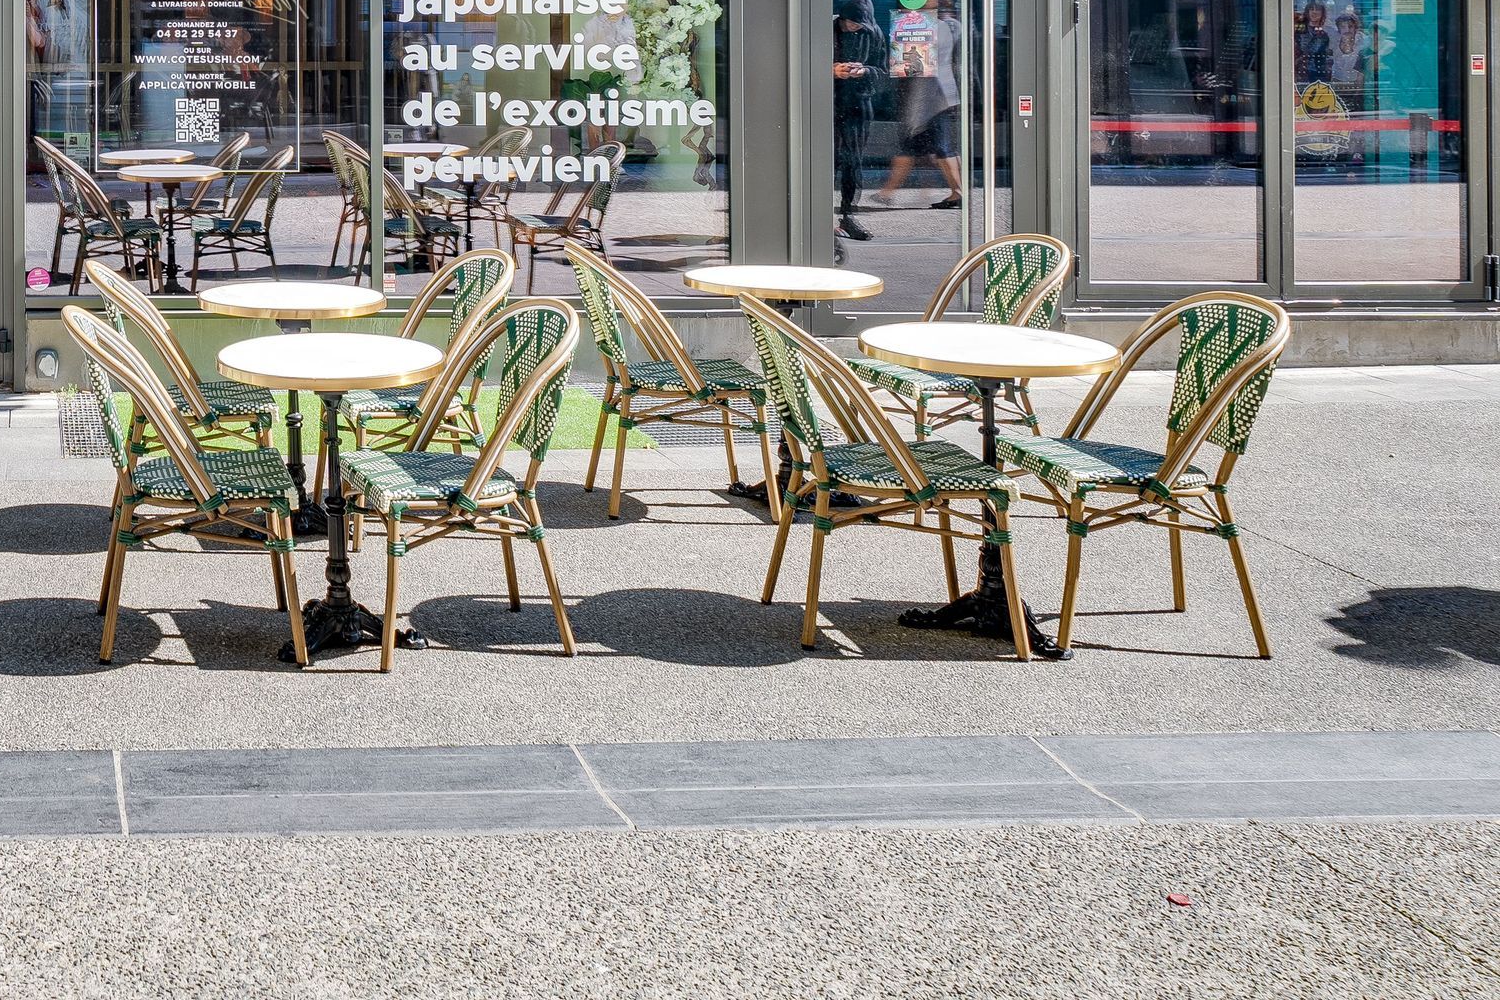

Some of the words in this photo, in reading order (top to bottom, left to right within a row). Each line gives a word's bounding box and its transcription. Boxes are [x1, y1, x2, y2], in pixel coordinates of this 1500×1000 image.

[157, 30, 171, 38] 04
[174, 30, 188, 38] 82
[191, 30, 204, 38] 29
[207, 30, 221, 38] 54
[225, 30, 238, 38] 37
[402, 43, 457, 70] au
[471, 34, 639, 71] service
[139, 82, 211, 90] APPLICATION
[215, 82, 256, 90] MOBILE
[402, 92, 461, 126] de
[404, 145, 611, 190] péruvien
